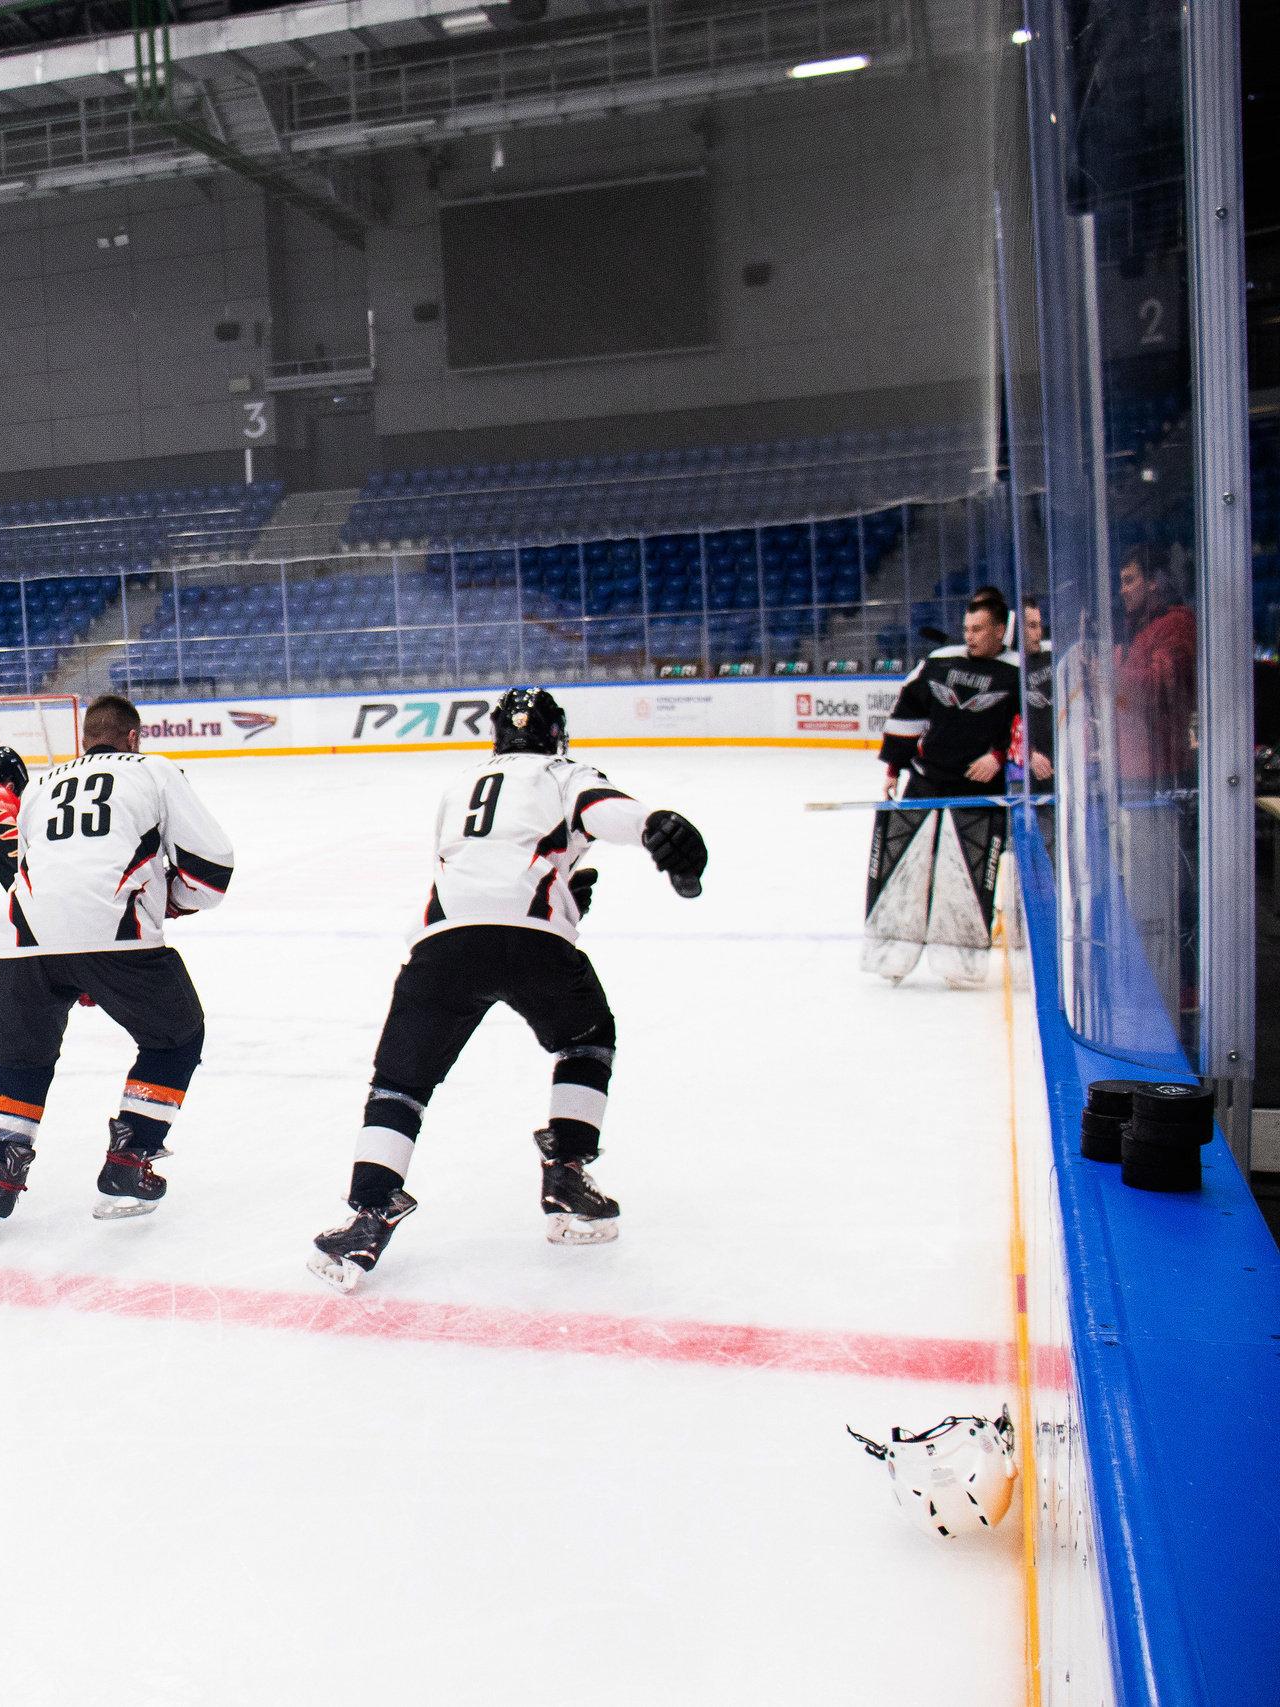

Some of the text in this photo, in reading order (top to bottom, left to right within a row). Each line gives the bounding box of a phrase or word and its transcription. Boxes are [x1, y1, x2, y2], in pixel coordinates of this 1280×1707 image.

[1139, 299, 1166, 344] 2
[243, 402, 267, 438] 3
[352, 700, 490, 739] PAR
[816, 699, 859, 716] Döcke
[46, 773, 115, 841] 33
[463, 772, 504, 838] 9
[985, 835, 1002, 891] BAUER
